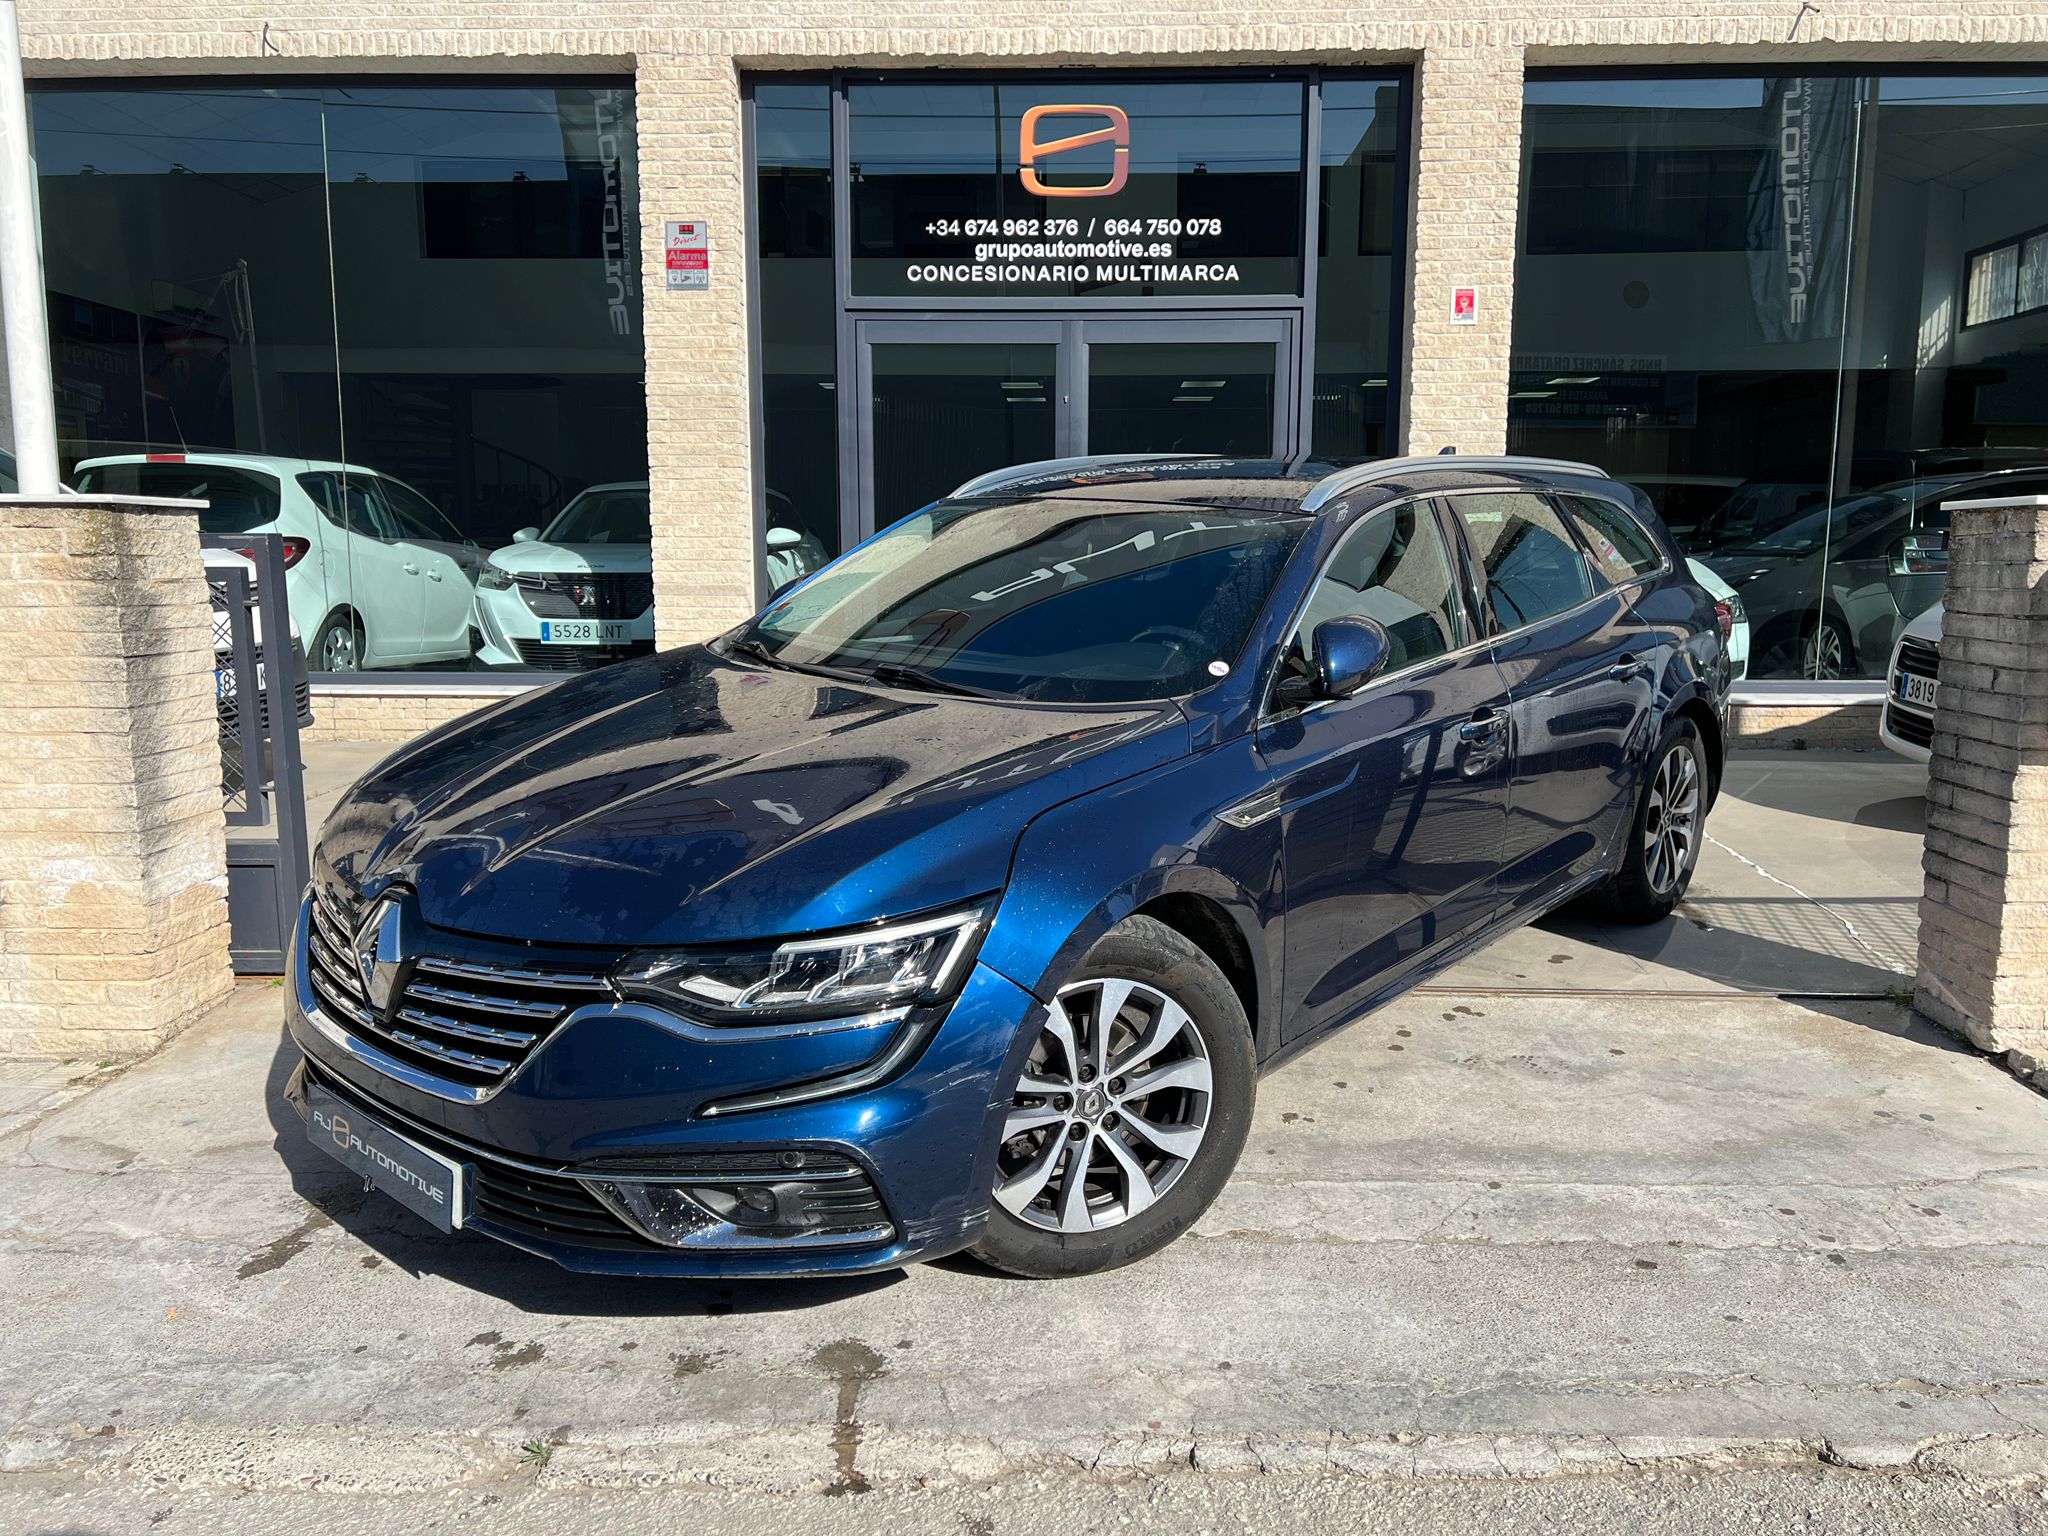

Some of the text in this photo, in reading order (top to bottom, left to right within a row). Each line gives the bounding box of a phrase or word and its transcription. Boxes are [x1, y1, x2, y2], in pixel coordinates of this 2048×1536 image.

[925, 219, 960, 236] +34
[964, 219, 998, 236] 674
[1003, 219, 1039, 236] 962
[1043, 219, 1079, 236] 376
[1104, 219, 1142, 236] 664
[1147, 219, 1182, 236] 750
[1186, 219, 1222, 236] 078
[669, 250, 707, 261] Alarma
[974, 239, 1172, 261] grupoautomotive.es
[906, 264, 1240, 282] CONCESIONARIO MULTIMARCA
[553, 624, 624, 639] 5528 LNT
[1908, 678, 1935, 703] 3819
[350, 1134, 444, 1205] AUTOMOTIVE
